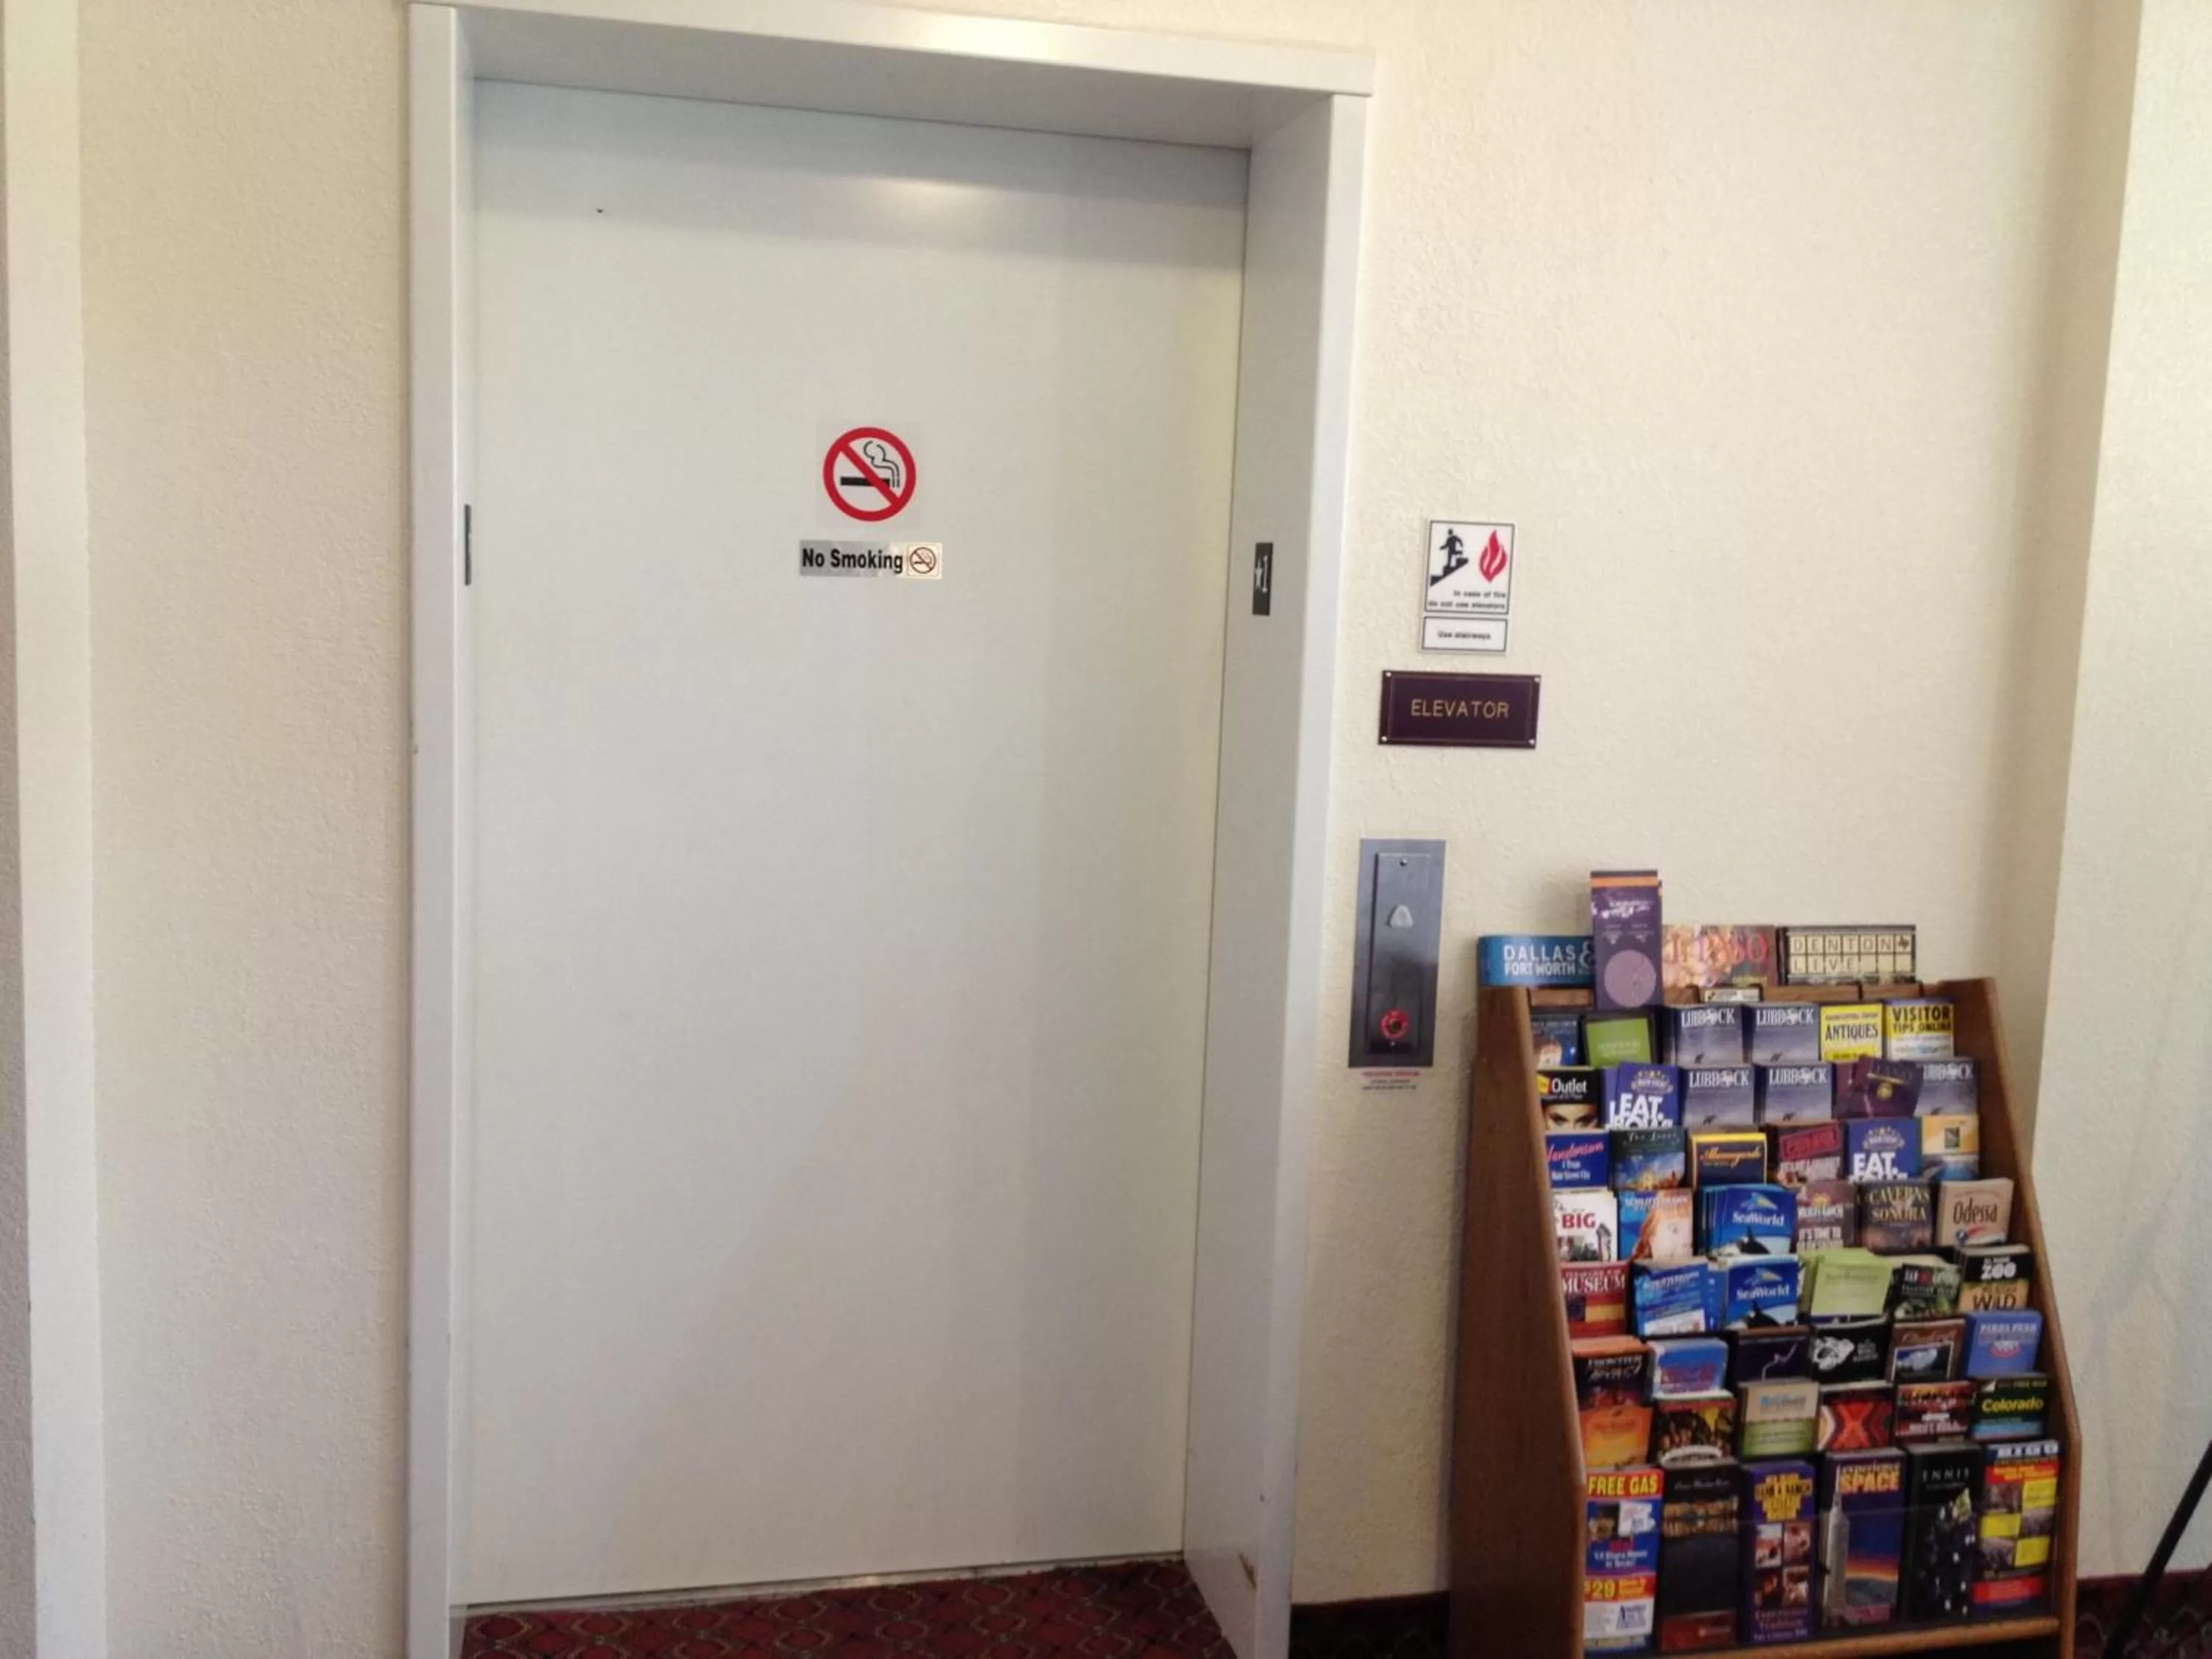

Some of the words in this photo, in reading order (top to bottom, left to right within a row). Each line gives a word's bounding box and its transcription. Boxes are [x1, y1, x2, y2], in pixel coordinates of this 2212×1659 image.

[801, 548, 825, 567] No
[830, 549, 903, 574] Smoking
[1411, 698, 1510, 719] ELEVATOR
[1792, 937, 1891, 951] DENTON
[1503, 944, 1576, 961] DALLAS
[1504, 963, 1532, 976] FORT
[1536, 962, 1576, 976] WORTH
[1793, 958, 1854, 971] LIVE
[1892, 1006, 1950, 1021] VISITOR
[1825, 1023, 1878, 1042] ANTIQUES
[1551, 1078, 1587, 1094] Outlet
[1733, 1211, 1785, 1226] SeaWorld
[1952, 1197, 1997, 1224] Odessa
[1562, 1213, 1596, 1229] BIG
[1736, 1284, 1790, 1301] SeaWorld
[1982, 1397, 2044, 1413] Colorado
[1588, 1475, 1626, 1496] FREE
[1629, 1474, 1658, 1494] GAS
